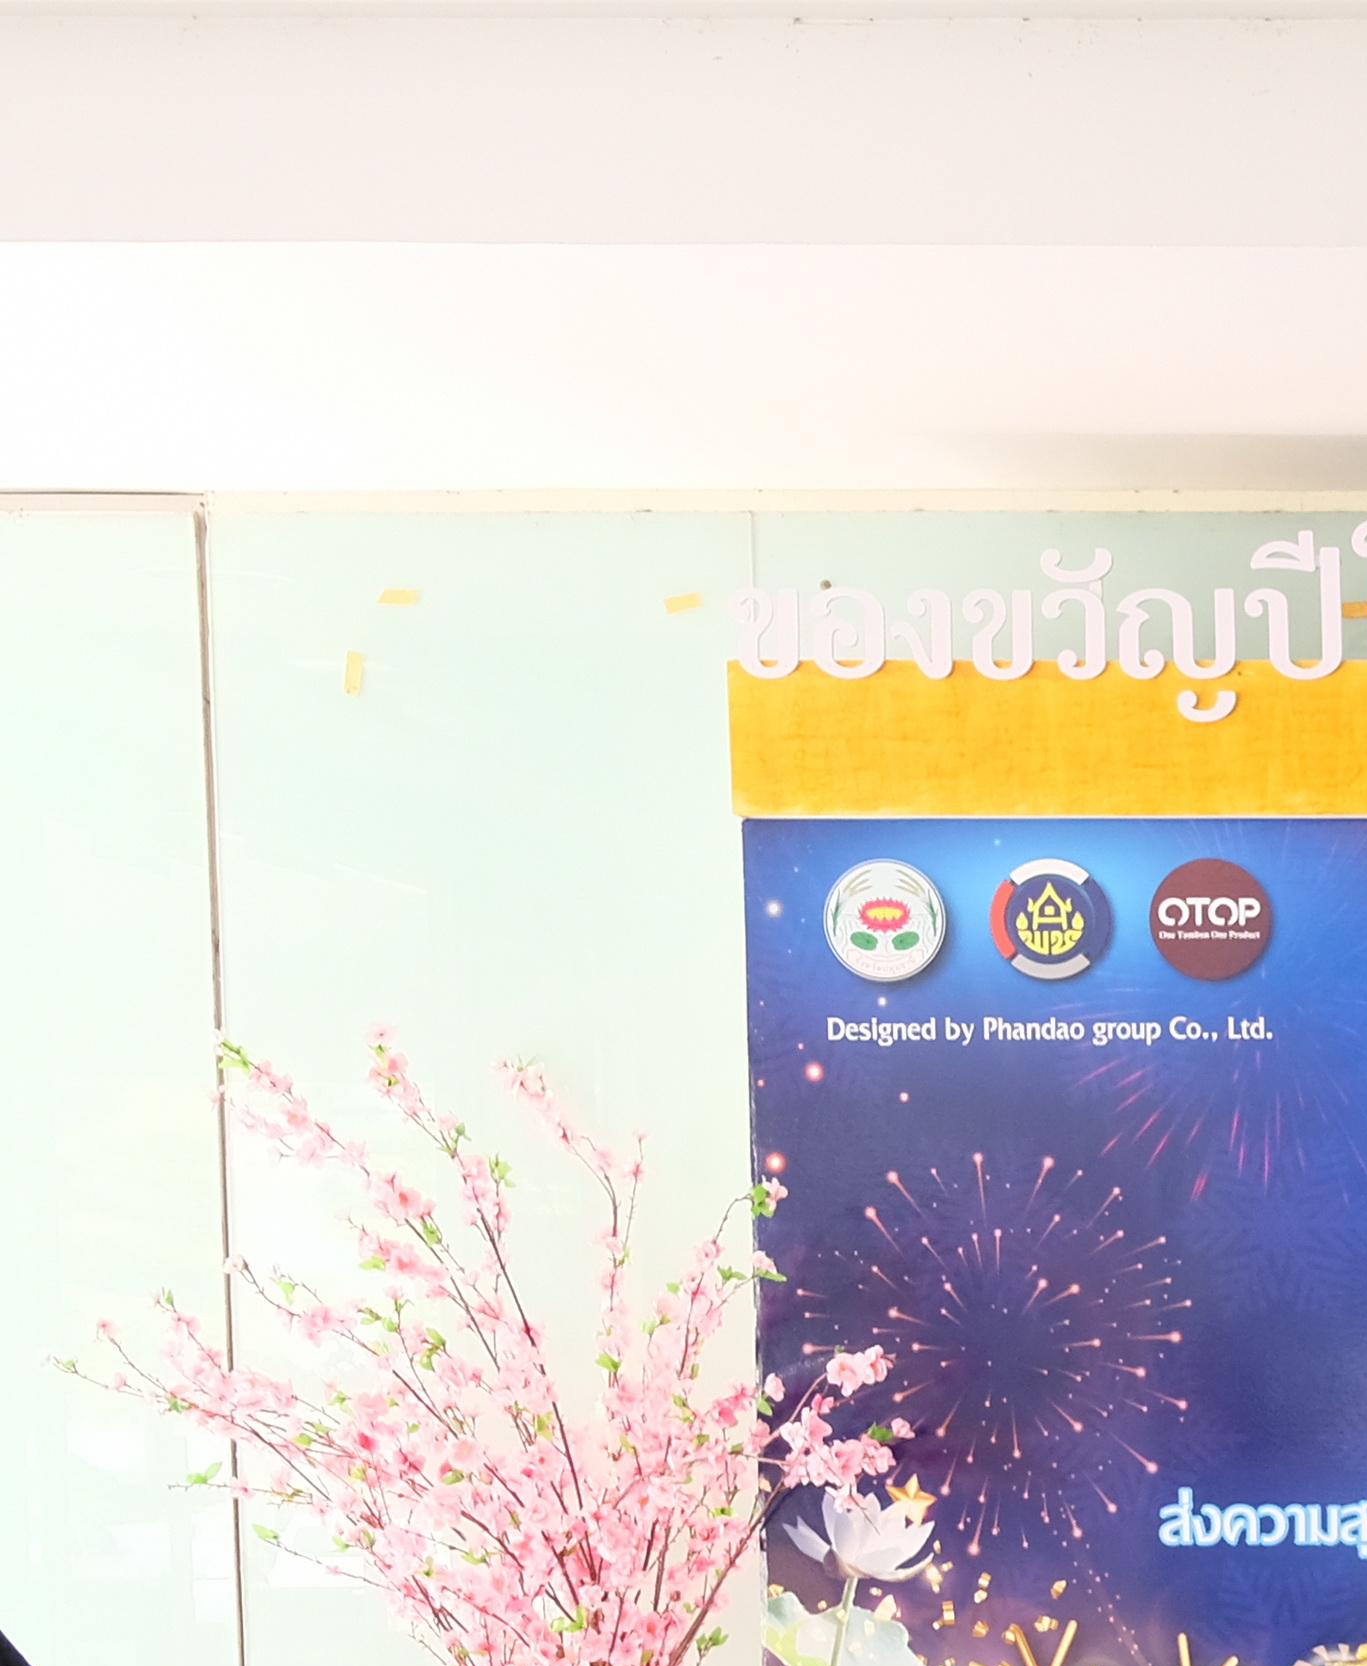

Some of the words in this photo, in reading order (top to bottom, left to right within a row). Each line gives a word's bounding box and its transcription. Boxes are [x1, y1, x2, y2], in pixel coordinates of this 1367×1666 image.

[1157, 896, 1262, 928] OTOP
[826, 1017, 937, 1047] Designed
[945, 1016, 975, 1047] by
[984, 1016, 1085, 1041] Phandao
[1092, 1022, 1162, 1047] group
[1168, 1016, 1219, 1044] Co.,
[1227, 1016, 1274, 1041] Ltd.
